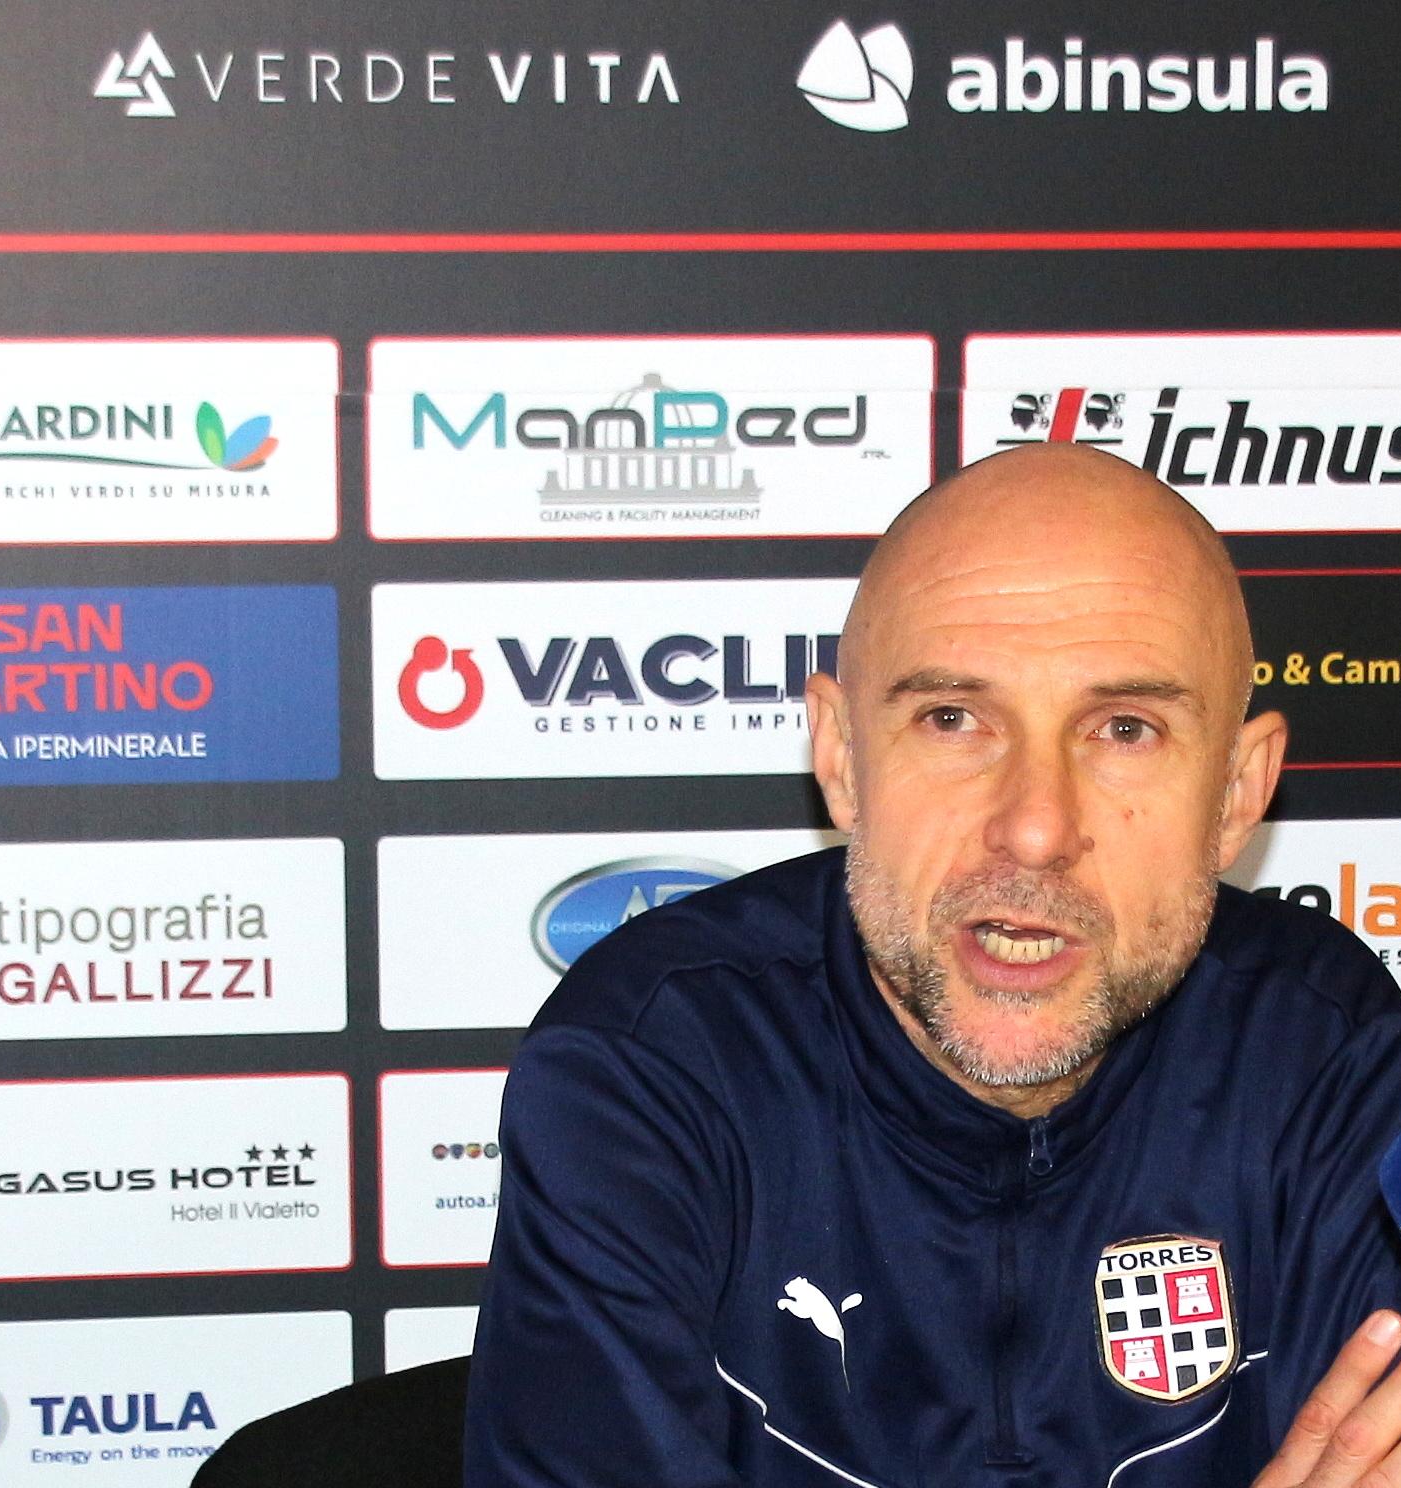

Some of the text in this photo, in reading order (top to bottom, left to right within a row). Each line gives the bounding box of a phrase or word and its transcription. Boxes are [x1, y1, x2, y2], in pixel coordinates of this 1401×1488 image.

[946, 37, 1330, 112] abinsula
[70, 487, 136, 499] VERDI
[149, 486, 173, 498] SU
[188, 485, 272, 498] MISURA
[540, 509, 603, 523] CLEANING
[619, 509, 667, 522] FACILITY
[671, 507, 762, 521] MANAGEMENT
[1283, 654, 1311, 687] &
[535, 714, 706, 733] GESTIONE
[14, 732, 207, 760] IPERMINERALE
[171, 1163, 317, 1190] HOTEL
[170, 1202, 223, 1222] Hotel
[242, 1199, 320, 1221] Vialetto
[1100, 1246, 1212, 1272] TORRES
[31, 1391, 217, 1436] TAULA
[31, 1447, 91, 1464] Energy
[101, 1449, 123, 1461] on
[130, 1445, 161, 1459] the
